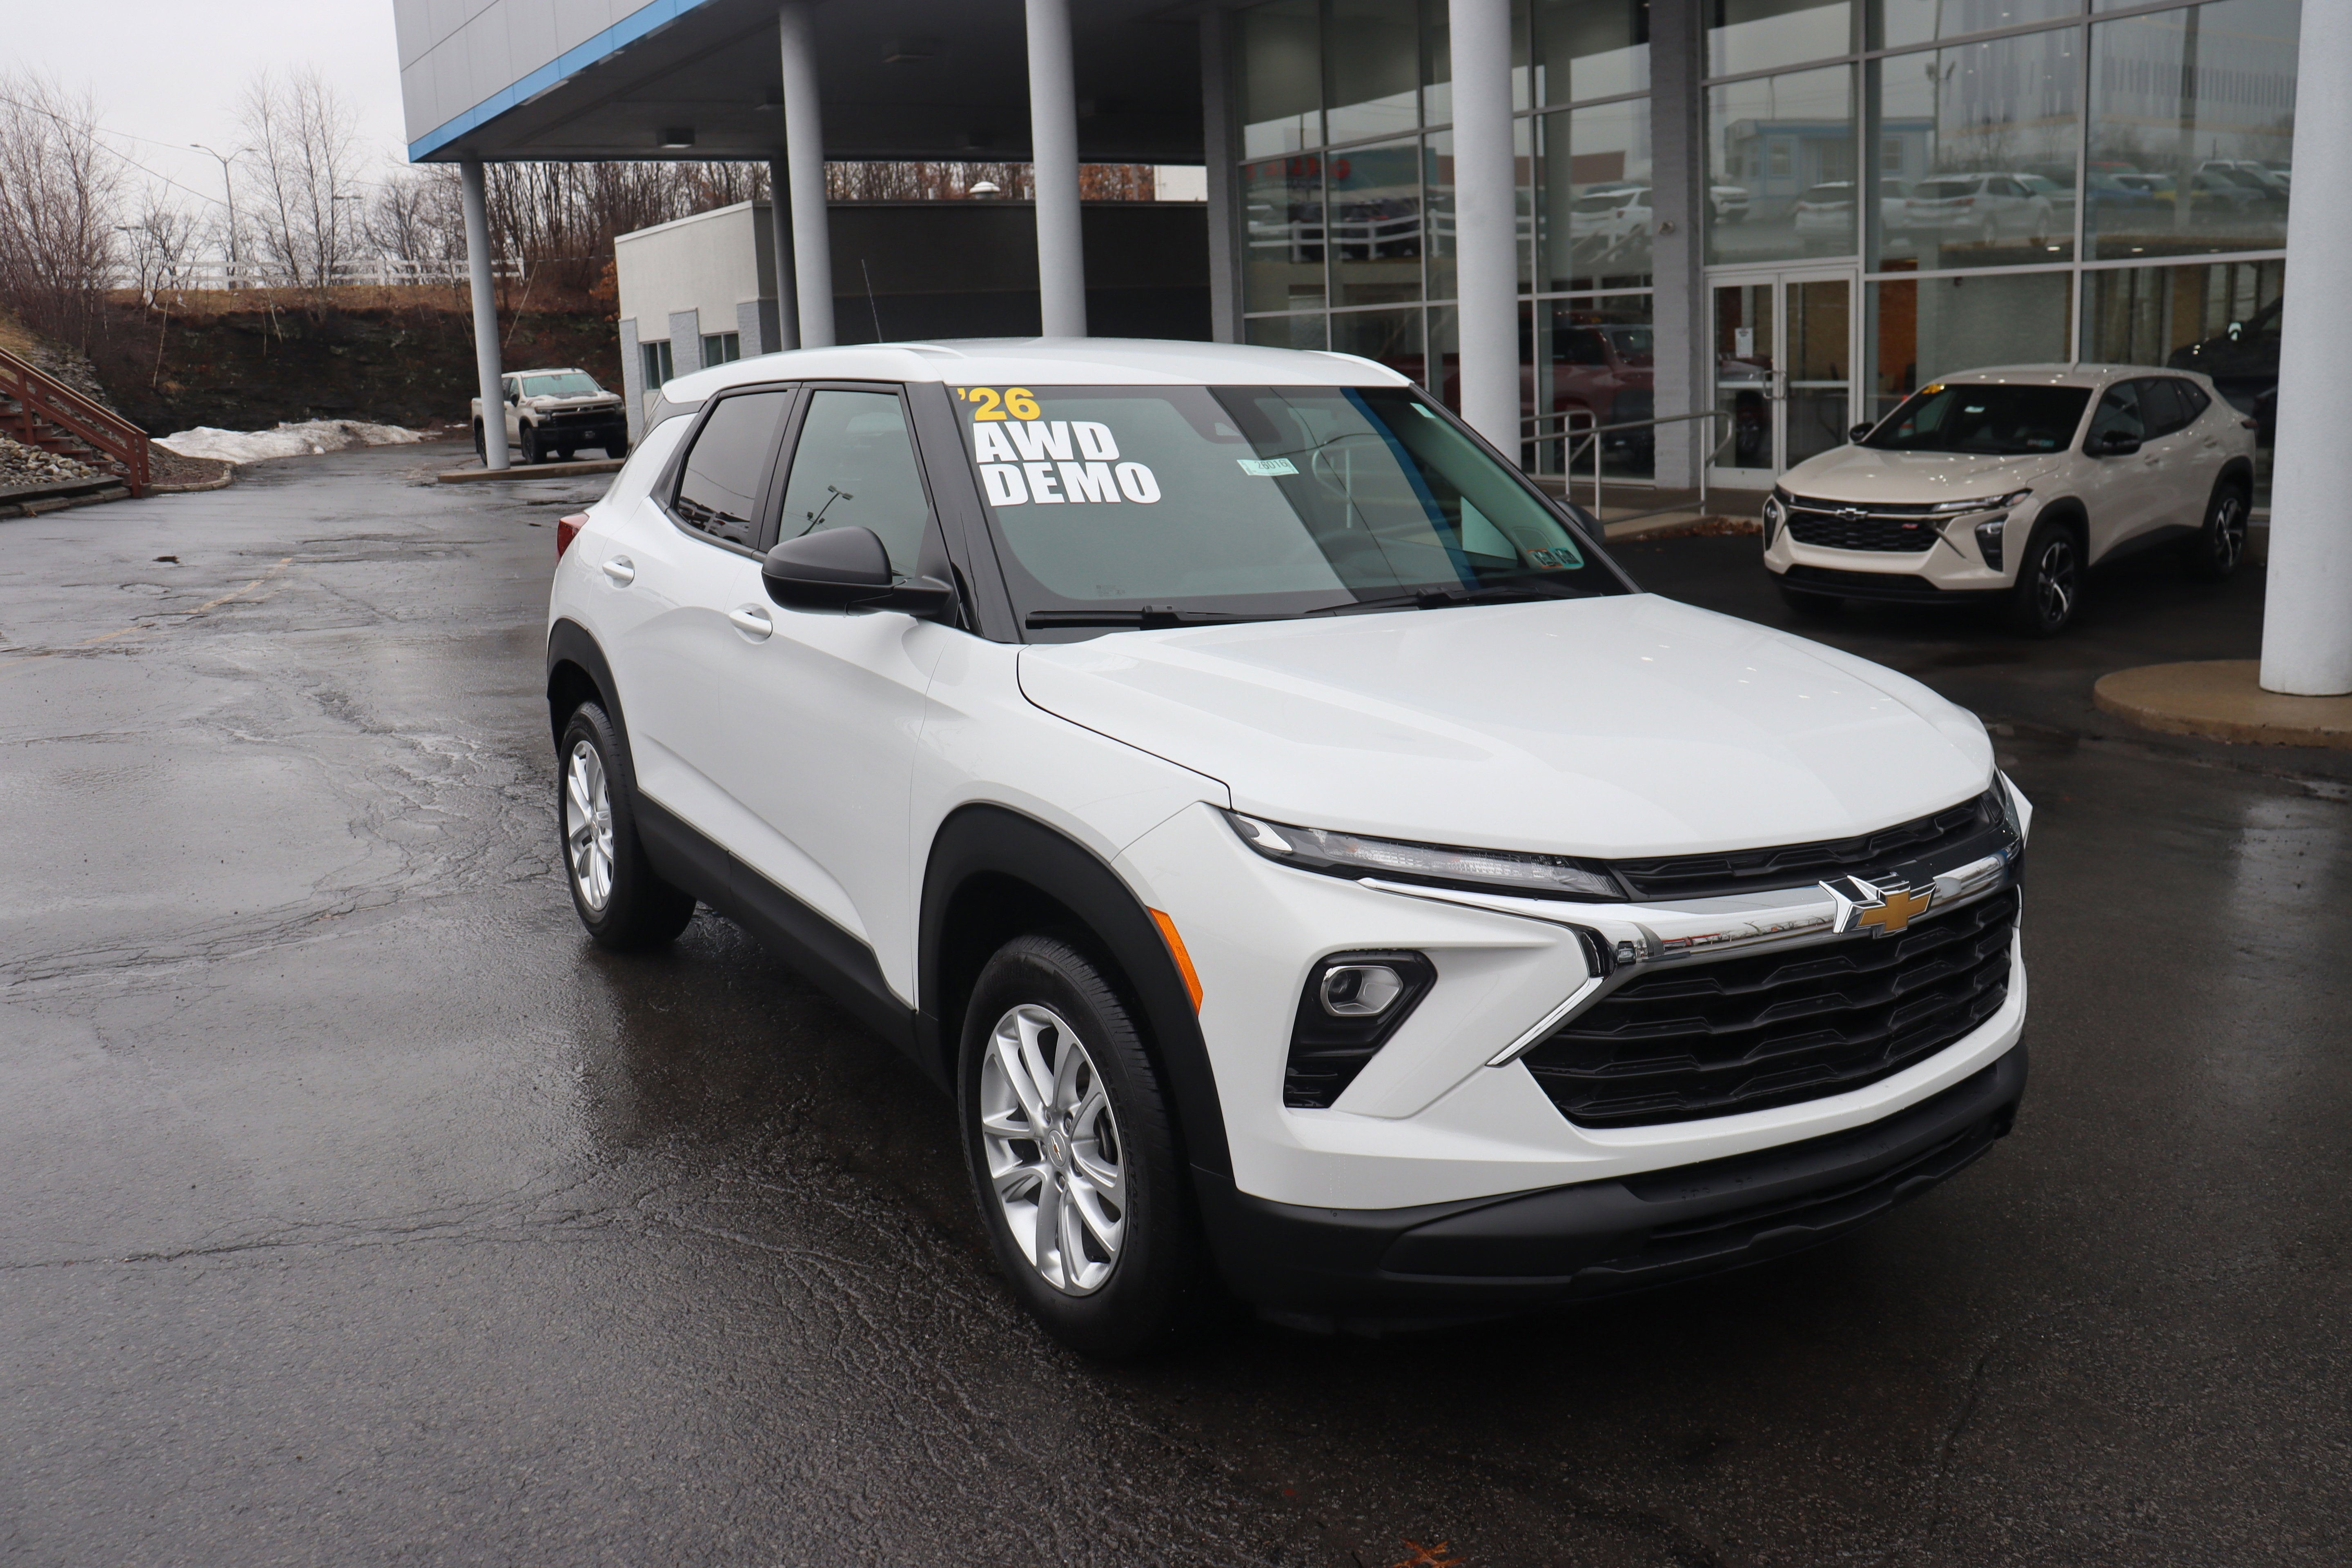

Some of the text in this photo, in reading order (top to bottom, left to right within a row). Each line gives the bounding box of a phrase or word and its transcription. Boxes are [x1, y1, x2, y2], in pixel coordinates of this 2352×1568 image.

[957, 387, 1040, 421] '26
[973, 421, 1120, 463] AWD
[1254, 459, 1287, 469] 26016
[979, 462, 1161, 506] DEMO
